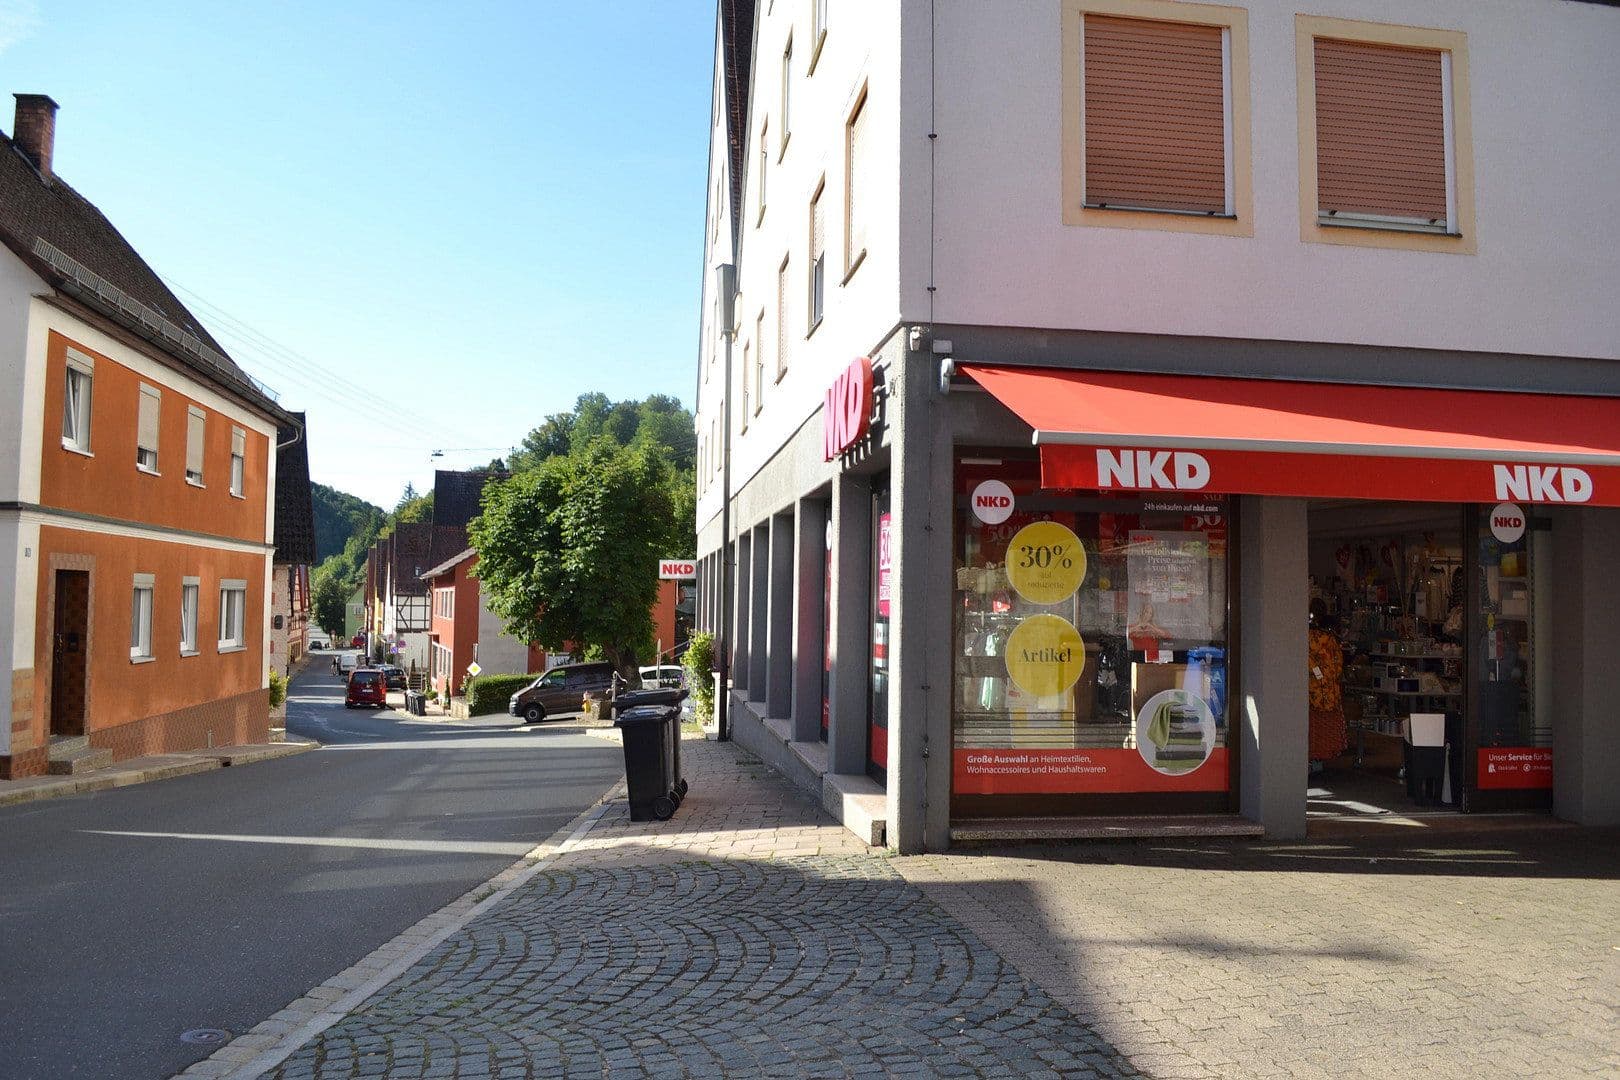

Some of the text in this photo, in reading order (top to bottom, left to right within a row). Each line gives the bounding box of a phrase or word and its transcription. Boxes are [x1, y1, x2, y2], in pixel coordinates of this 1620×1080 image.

[824, 357, 873, 462] NKD
[1096, 448, 1210, 490] NKD
[1493, 464, 1593, 503] NKD
[976, 495, 1010, 508] NKD
[1156, 503, 1182, 511] einkaufen
[1193, 503, 1219, 512] nkd.com
[1494, 517, 1522, 528] NKD
[1020, 545, 1072, 569] 30%
[662, 564, 694, 574] NKD
[1020, 648, 1072, 662] Artikel
[967, 755, 993, 764] Große
[994, 755, 1028, 764] Auswahl
[1040, 755, 1092, 763] Heimtextilien,
[1488, 753, 1507, 761] Unser
[1508, 753, 1533, 761] Service
[967, 765, 1107, 774] Wohnaccessoires und Haushaltswaren
